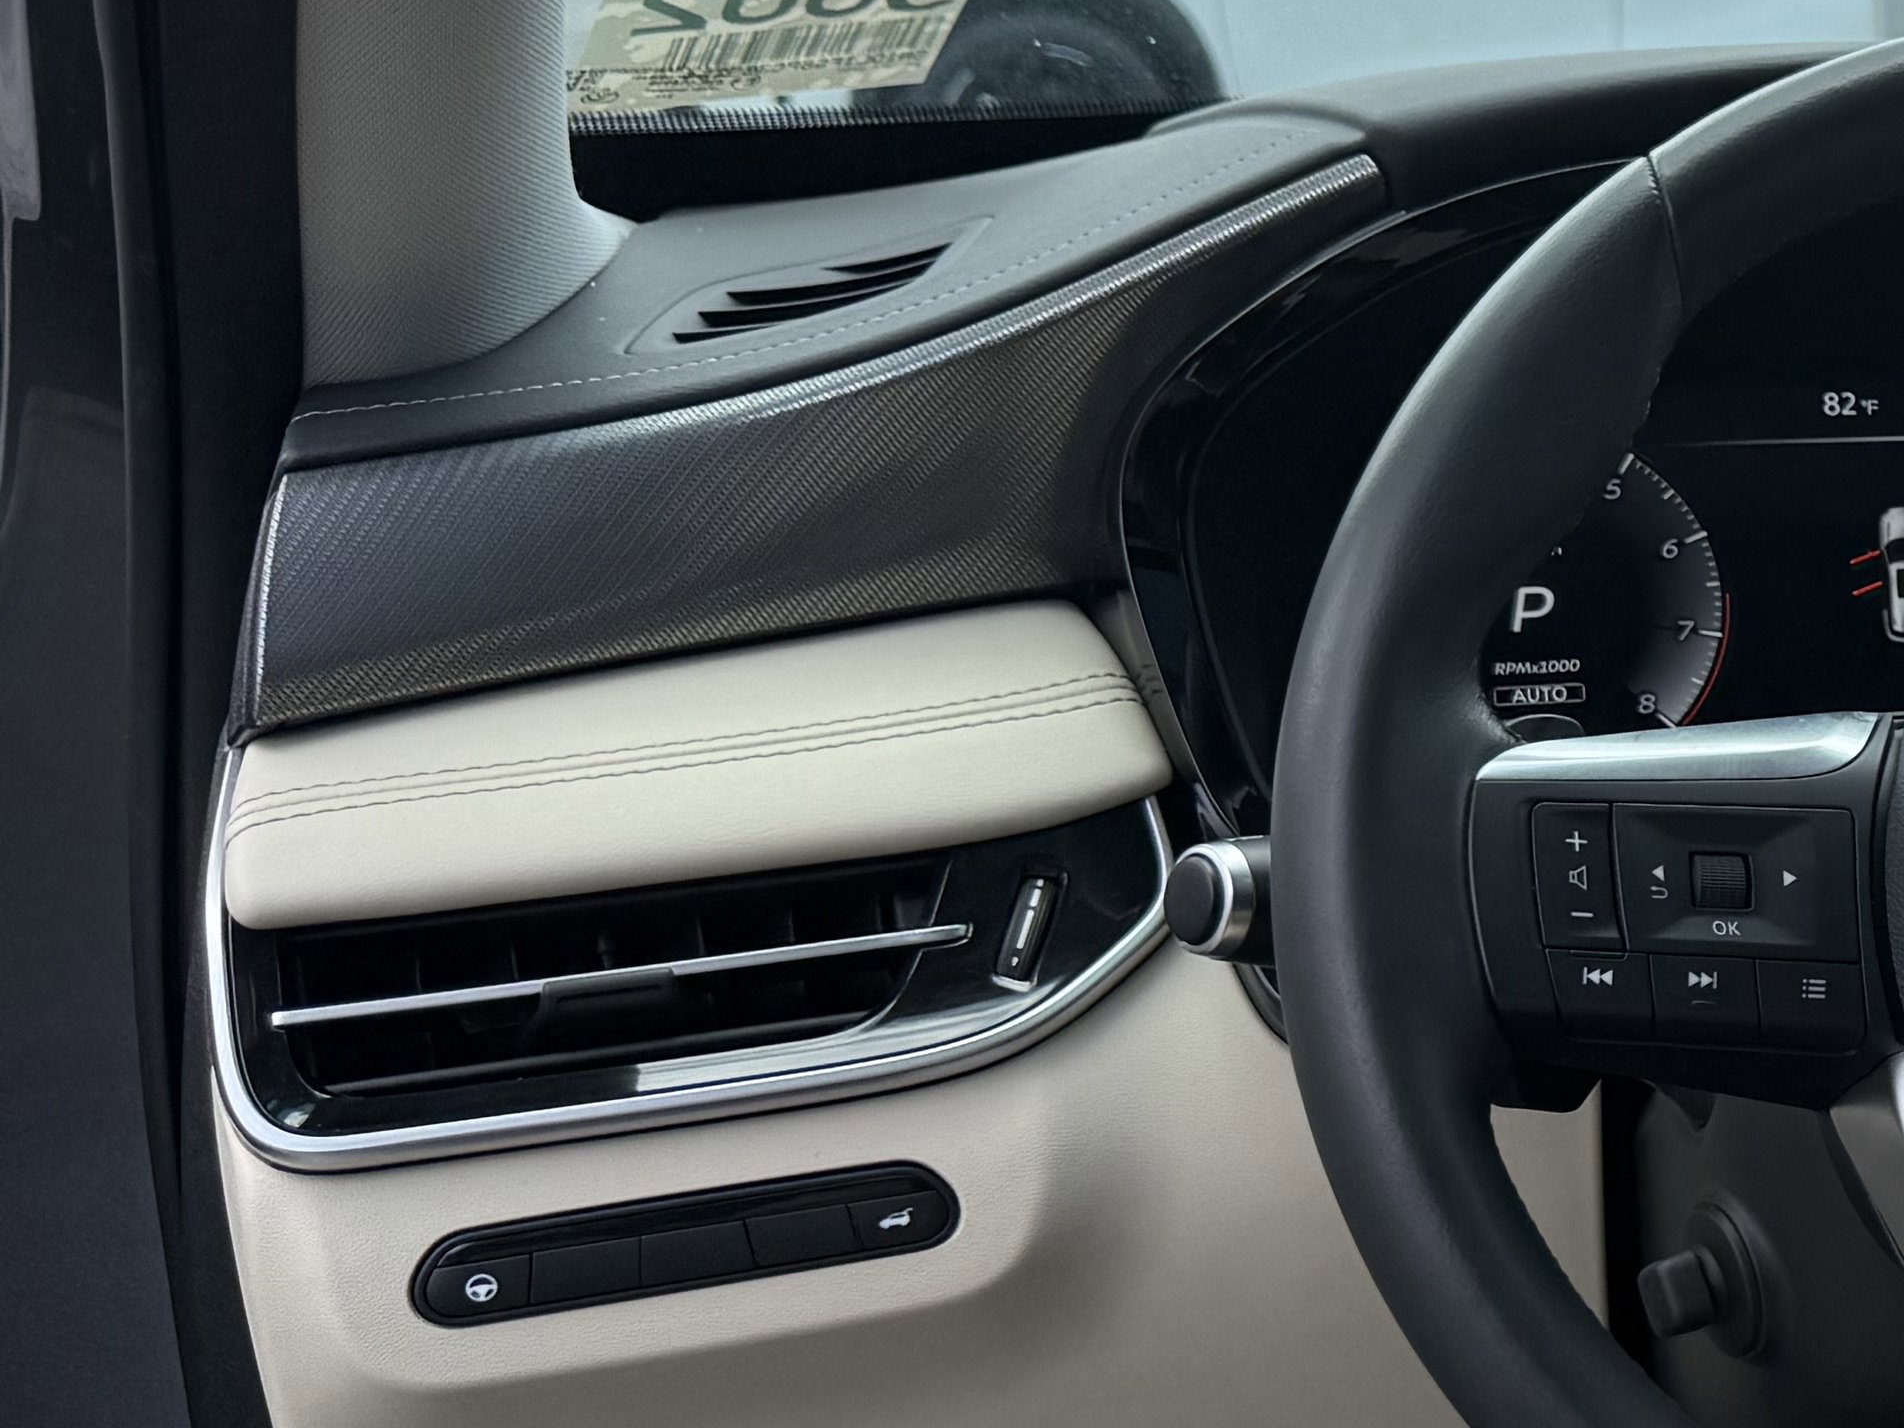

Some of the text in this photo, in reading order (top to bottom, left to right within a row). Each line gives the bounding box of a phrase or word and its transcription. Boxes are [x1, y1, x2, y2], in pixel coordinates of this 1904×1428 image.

[1603, 478, 1622, 500] 5
[1661, 538, 1679, 560] 6
[1509, 585, 1556, 633] P
[1677, 620, 1695, 641] 7
[1512, 685, 1568, 703] AUTO
[1638, 693, 1656, 715] 8
[1712, 919, 1742, 936] OK
